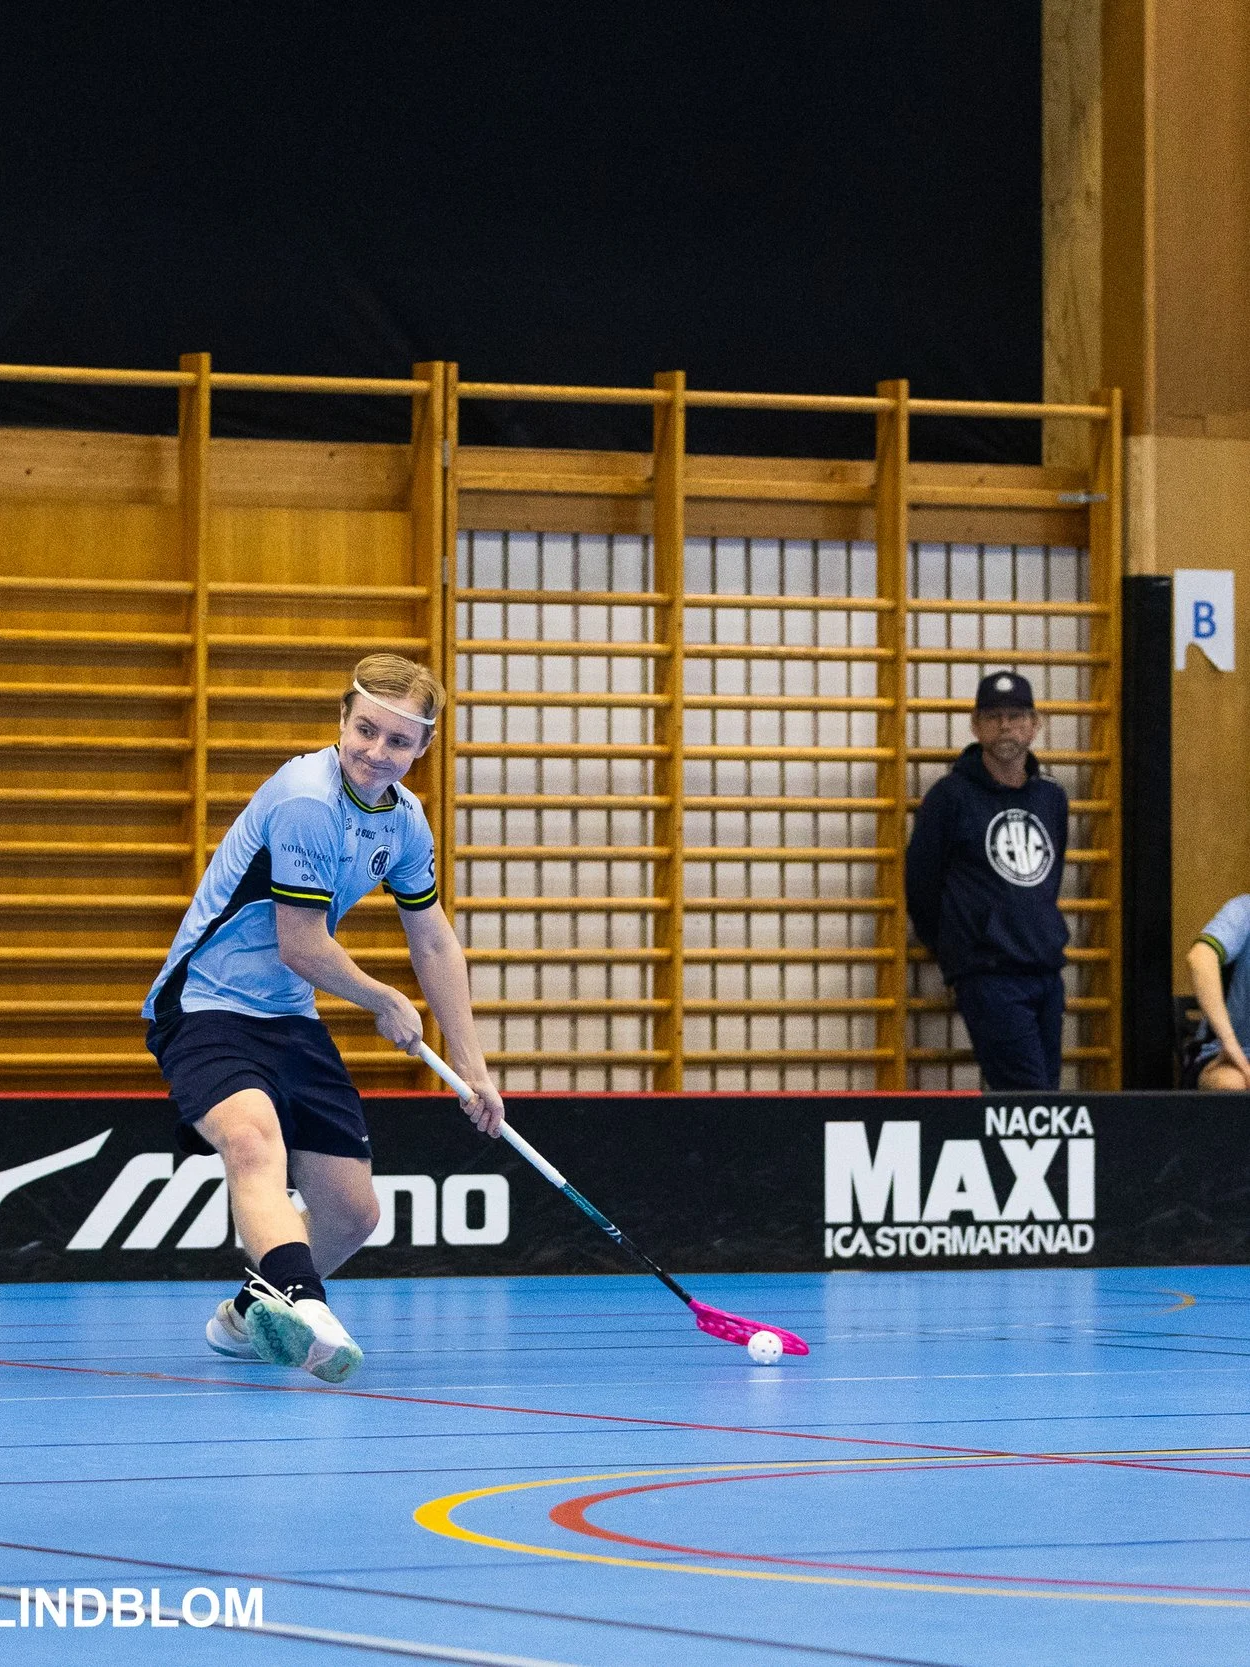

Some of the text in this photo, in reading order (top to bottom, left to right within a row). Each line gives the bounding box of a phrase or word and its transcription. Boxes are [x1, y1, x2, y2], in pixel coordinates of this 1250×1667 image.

[1193, 601, 1216, 638] B
[985, 1106, 1094, 1137] NACKA
[824, 1120, 1095, 1223] MAXI
[875, 1224, 1095, 1257] STORMARKNAD
